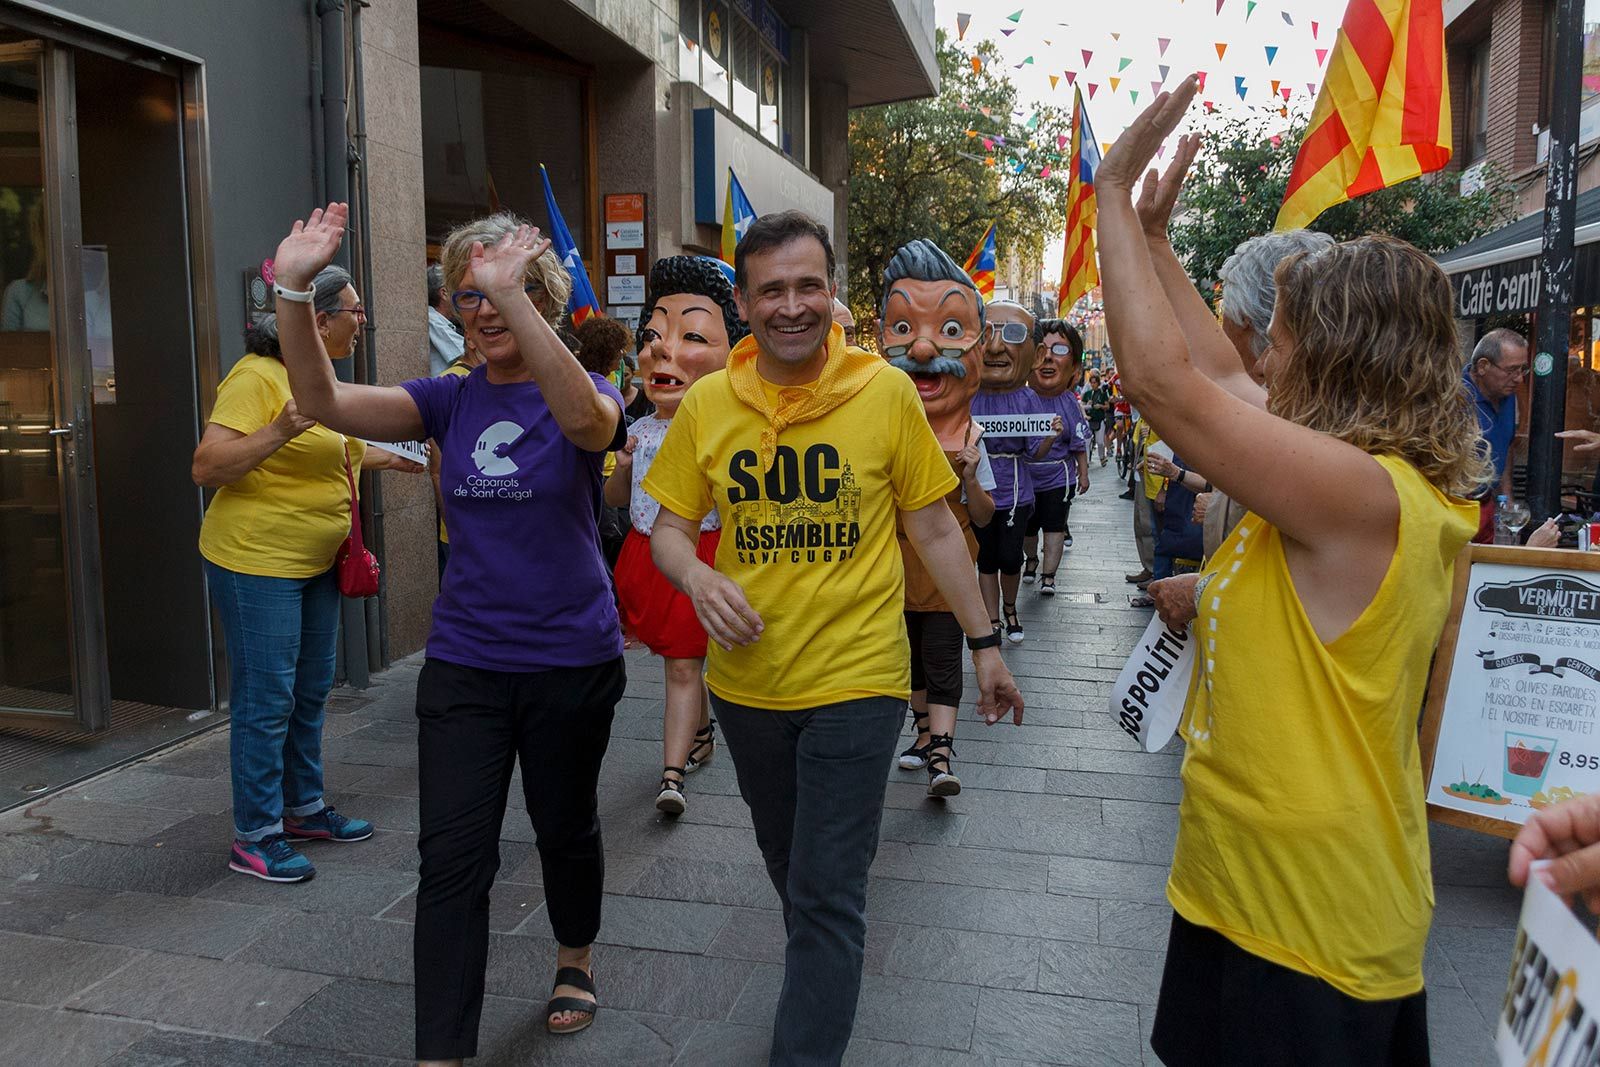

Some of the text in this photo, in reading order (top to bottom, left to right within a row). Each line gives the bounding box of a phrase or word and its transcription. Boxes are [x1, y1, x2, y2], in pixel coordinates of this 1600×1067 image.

[1460, 269, 1493, 316] Cafè
[1009, 417, 1051, 433] POLÍTICS
[467, 475, 519, 489] Caparrots
[727, 443, 840, 505] SOC
[453, 484, 533, 501] de Sant Cugat
[735, 522, 861, 550] ASSEMBLEA
[738, 551, 779, 565] SANT
[1556, 579, 1564, 589] EL
[1518, 587, 1600, 610] VERMUTET
[1536, 605, 1575, 617] DE LA CASA
[1490, 620, 1515, 632] PER
[1521, 621, 1530, 632] A
[1535, 623, 1543, 633] 2
[1495, 654, 1525, 667] GAUDEIX
[1566, 659, 1597, 679] CENTRAL
[1515, 680, 1548, 695] OLIVES
[1485, 692, 1597, 718] MUSCLOS EN ESCABETX
[1488, 708, 1497, 720] EL
[1502, 710, 1541, 727] NOSTRE
[1545, 716, 1594, 735] VERMUTET
[1559, 751, 1599, 770] 8,95
